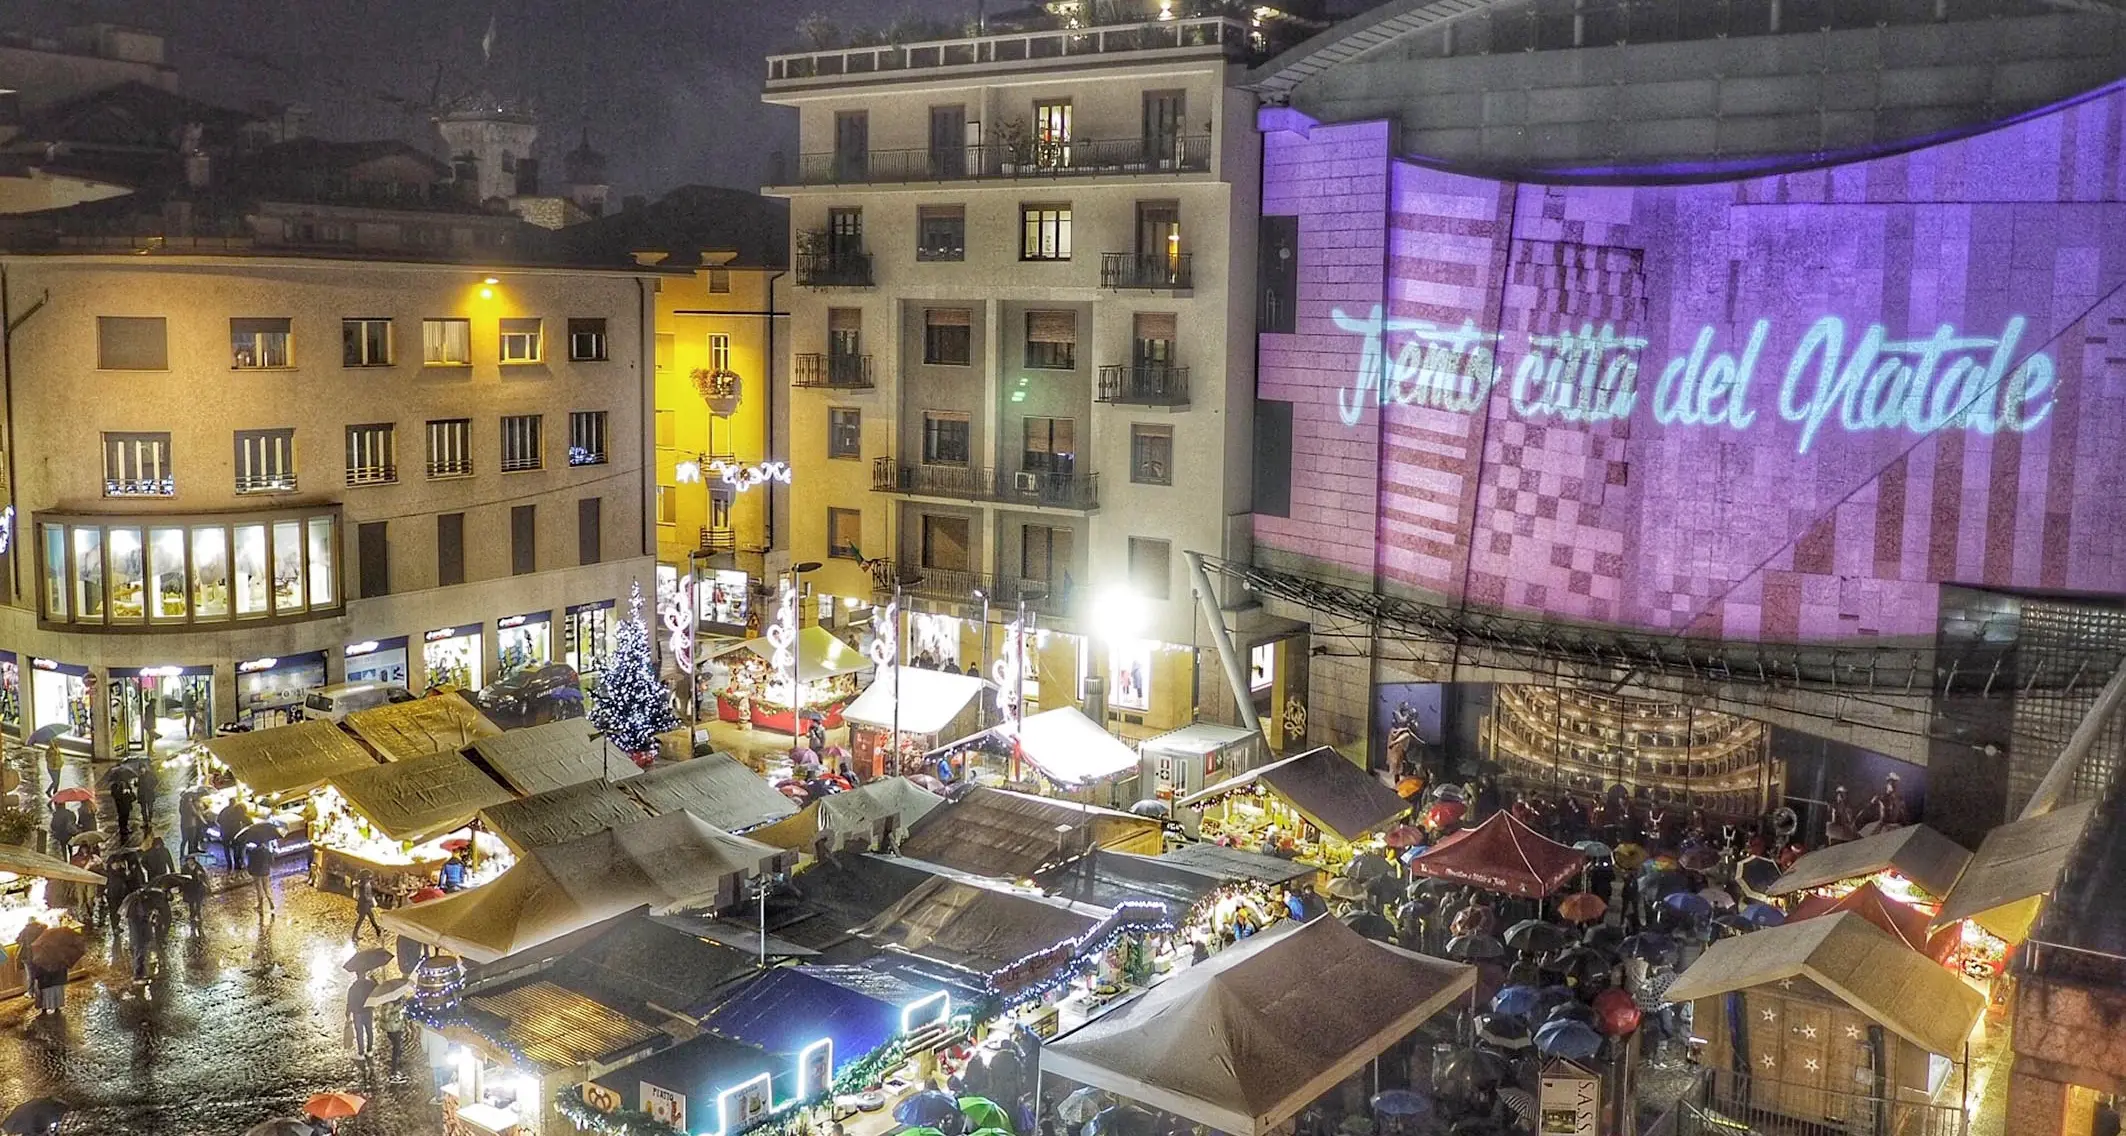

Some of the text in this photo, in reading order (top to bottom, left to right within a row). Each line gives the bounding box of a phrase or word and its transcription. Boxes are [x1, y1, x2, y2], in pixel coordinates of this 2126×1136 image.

[1332, 304, 1503, 425] Trento
[1653, 319, 1769, 429] del
[1780, 316, 2056, 454] Natale
